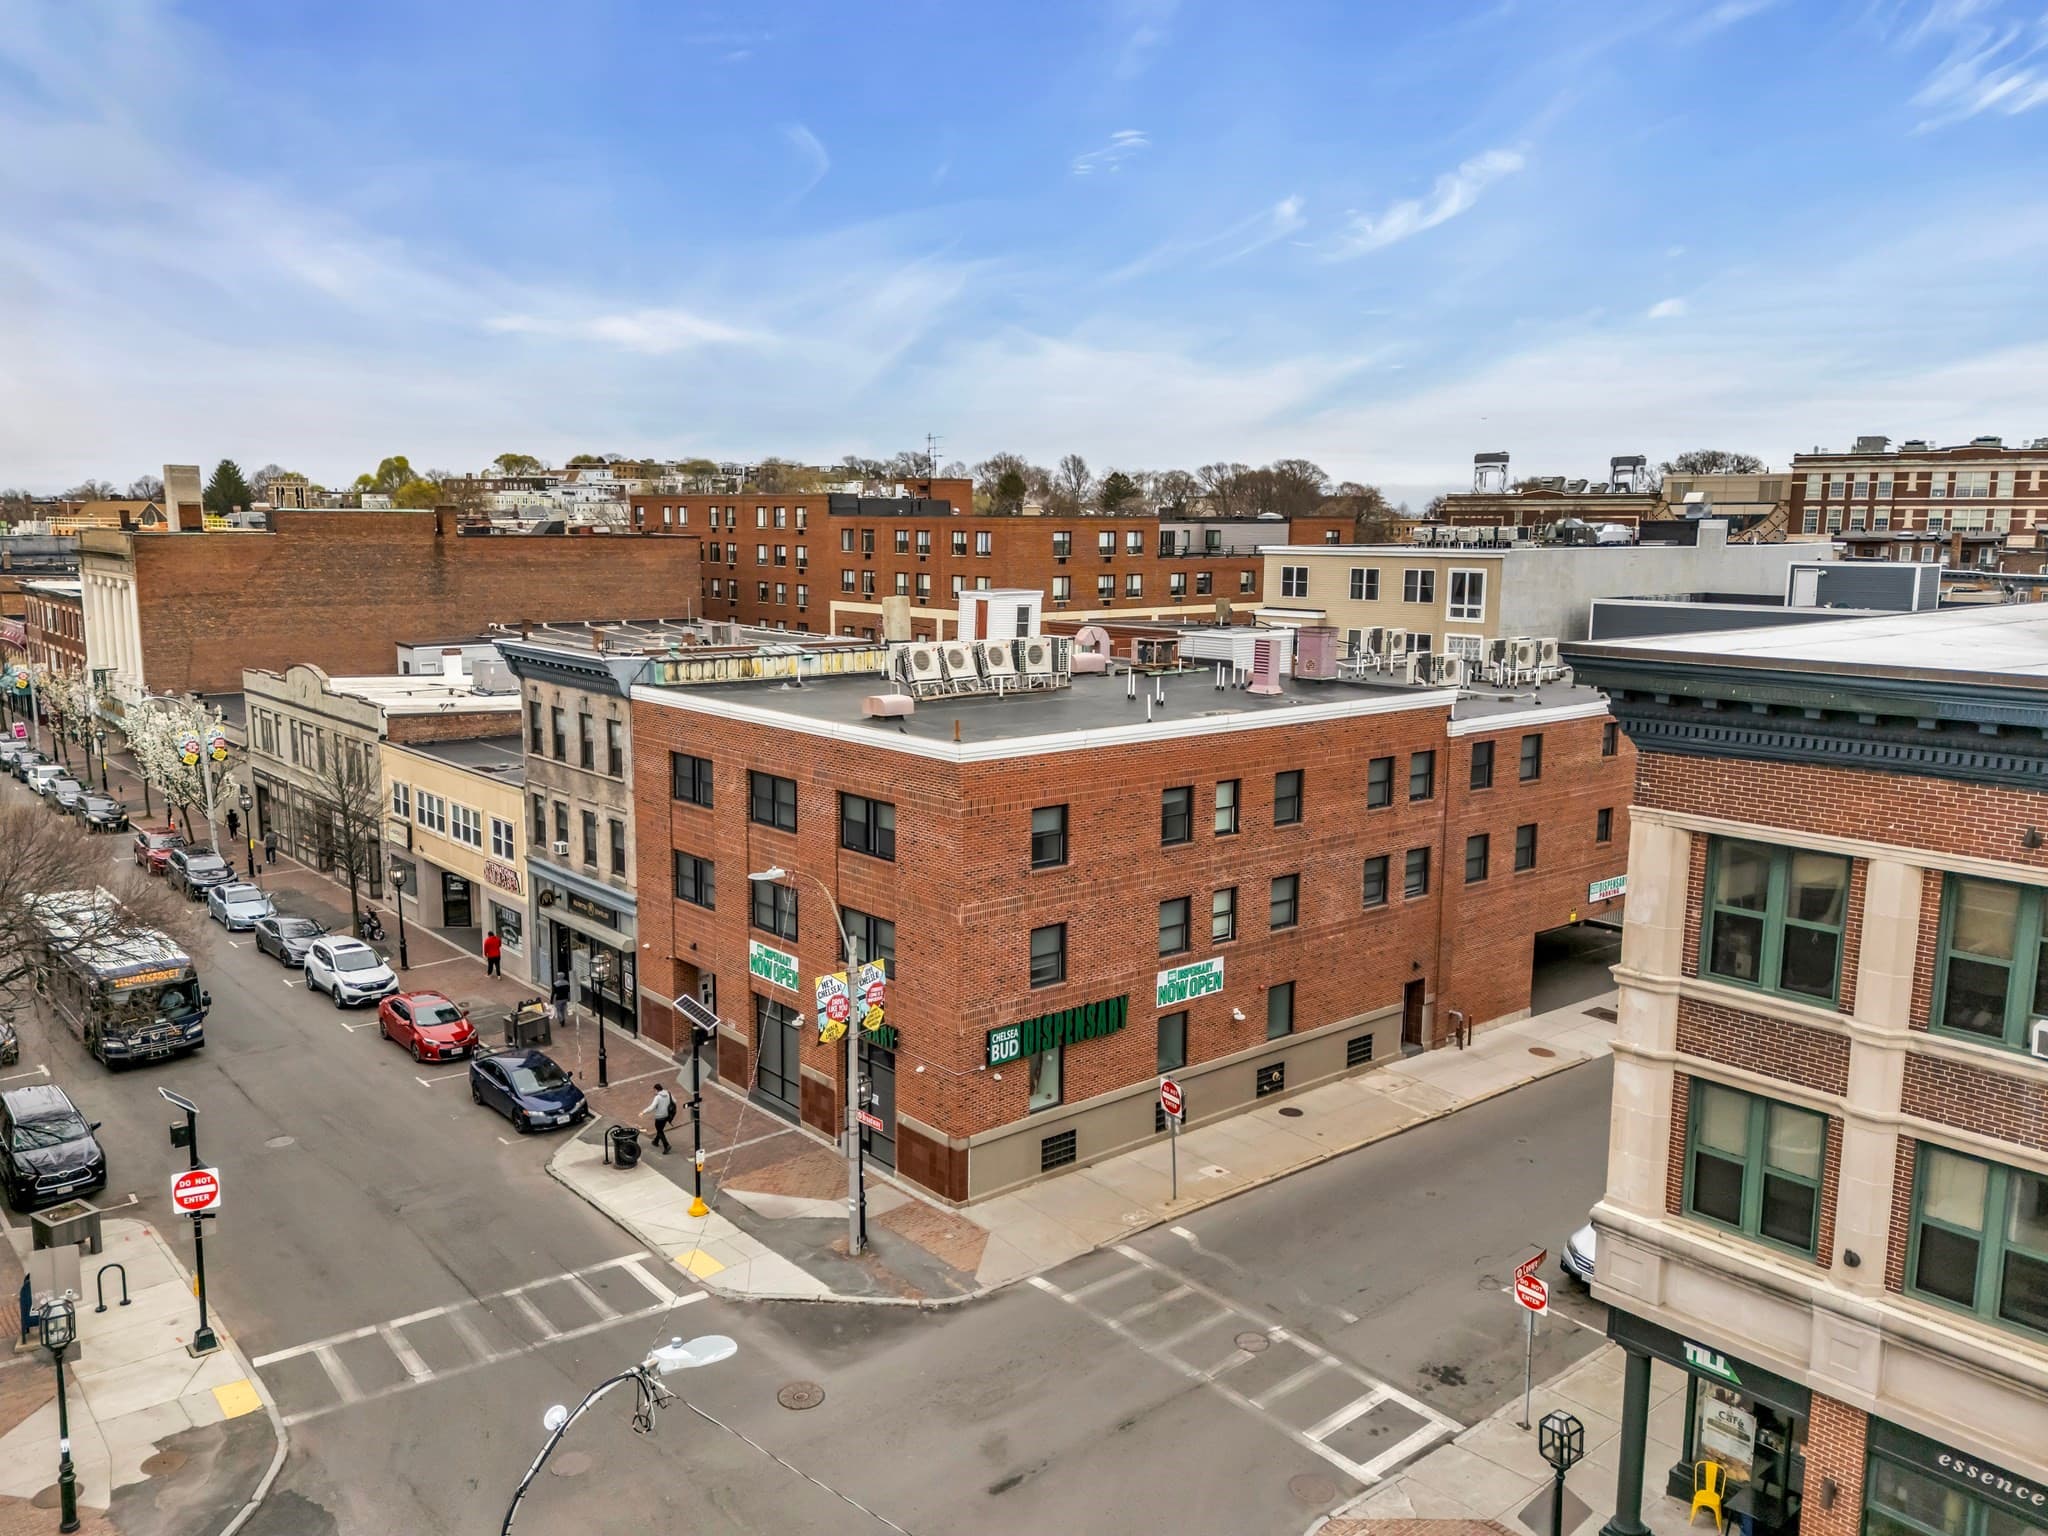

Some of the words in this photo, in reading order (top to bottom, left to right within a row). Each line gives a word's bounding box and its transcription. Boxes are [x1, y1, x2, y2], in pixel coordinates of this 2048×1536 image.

[1600, 888, 1619, 898] PARKING
[751, 953, 772, 979] NOW
[774, 963, 798, 990] OPEN
[821, 978, 833, 990] HEY
[1158, 979, 1188, 1006] NOW
[1189, 970, 1222, 997] OPEN
[1022, 994, 1129, 1057] DISPENSARY
[992, 1028, 1018, 1043] CHELSEA
[991, 1040, 1018, 1061] BUD
[1165, 1100, 1177, 1109] ENTER
[195, 1176, 211, 1184] NOT
[184, 1194, 209, 1204] ENTER
[1520, 1278, 1529, 1286] DO
[1531, 1283, 1543, 1293] NOT
[1521, 1294, 1540, 1306] ENTER
[1683, 1341, 1731, 1377] TILL
[1938, 1454, 2046, 1506] essence
